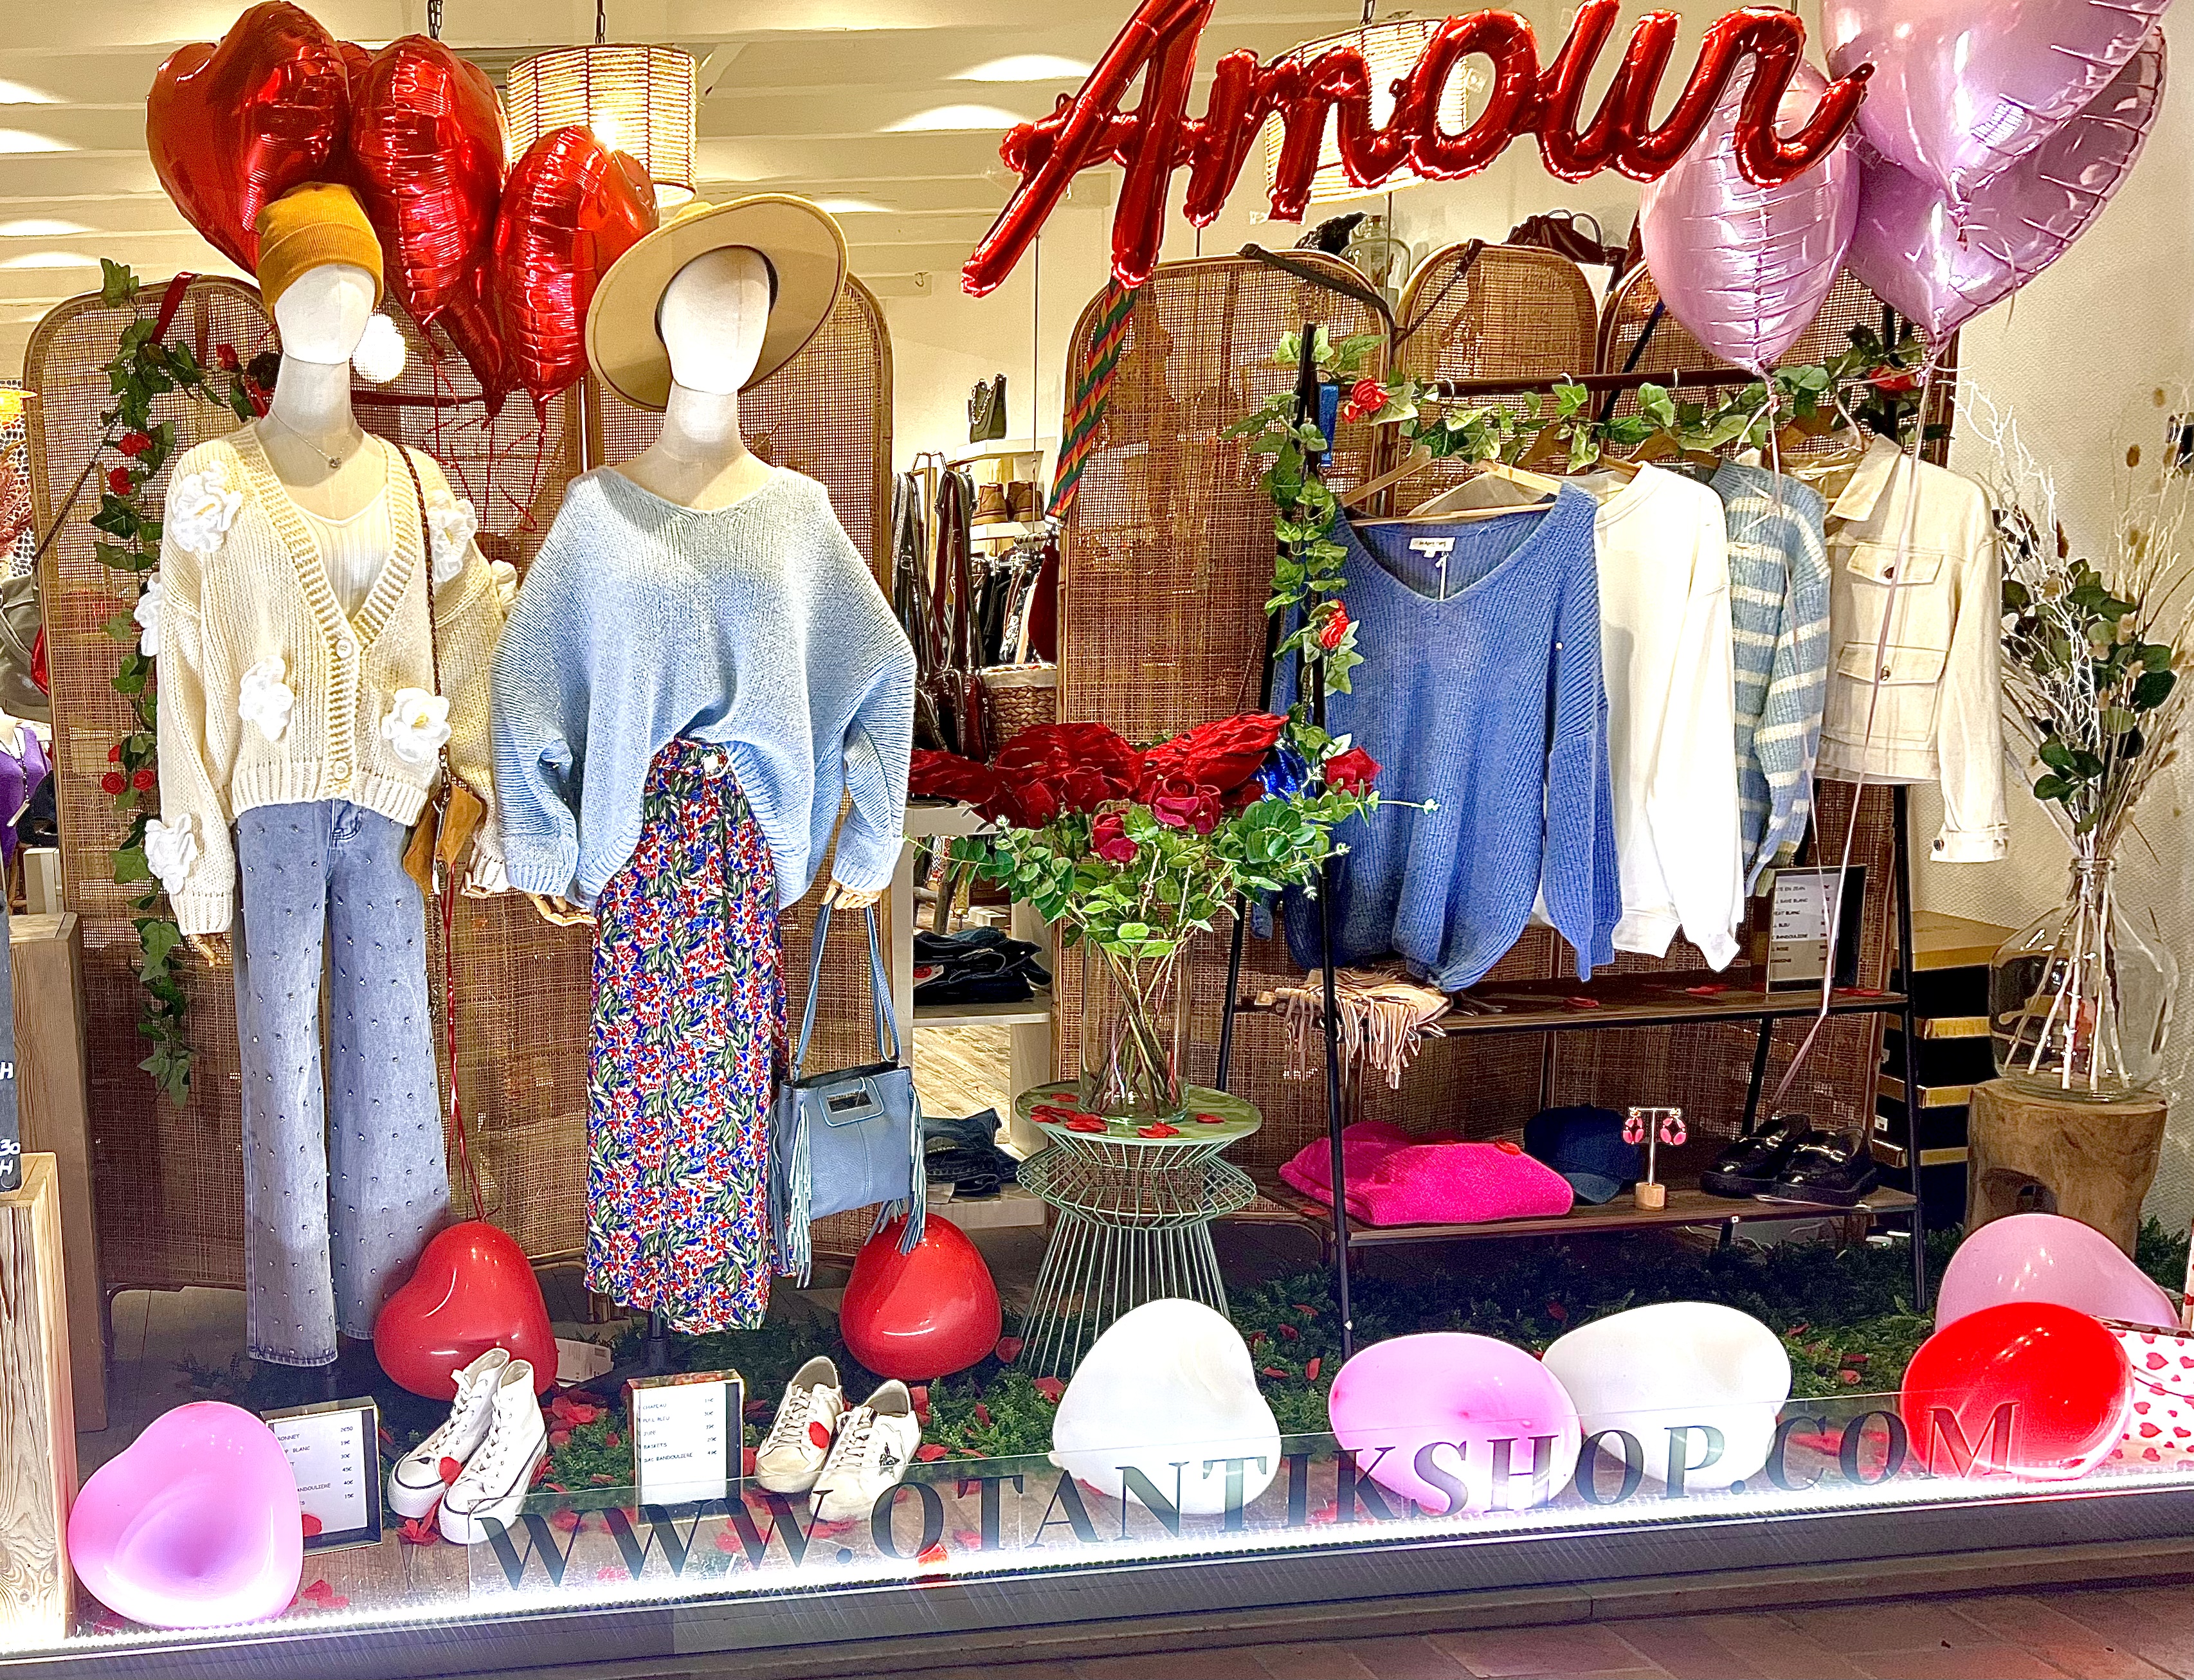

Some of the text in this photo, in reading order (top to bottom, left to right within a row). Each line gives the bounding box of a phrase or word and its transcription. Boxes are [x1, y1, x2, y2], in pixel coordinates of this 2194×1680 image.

[961, 0, 1874, 298] Amour
[297, 1483, 331, 1492] ANDOULIERE
[473, 1402, 2019, 1591] WWW.OTANTIKSHOP.COM
